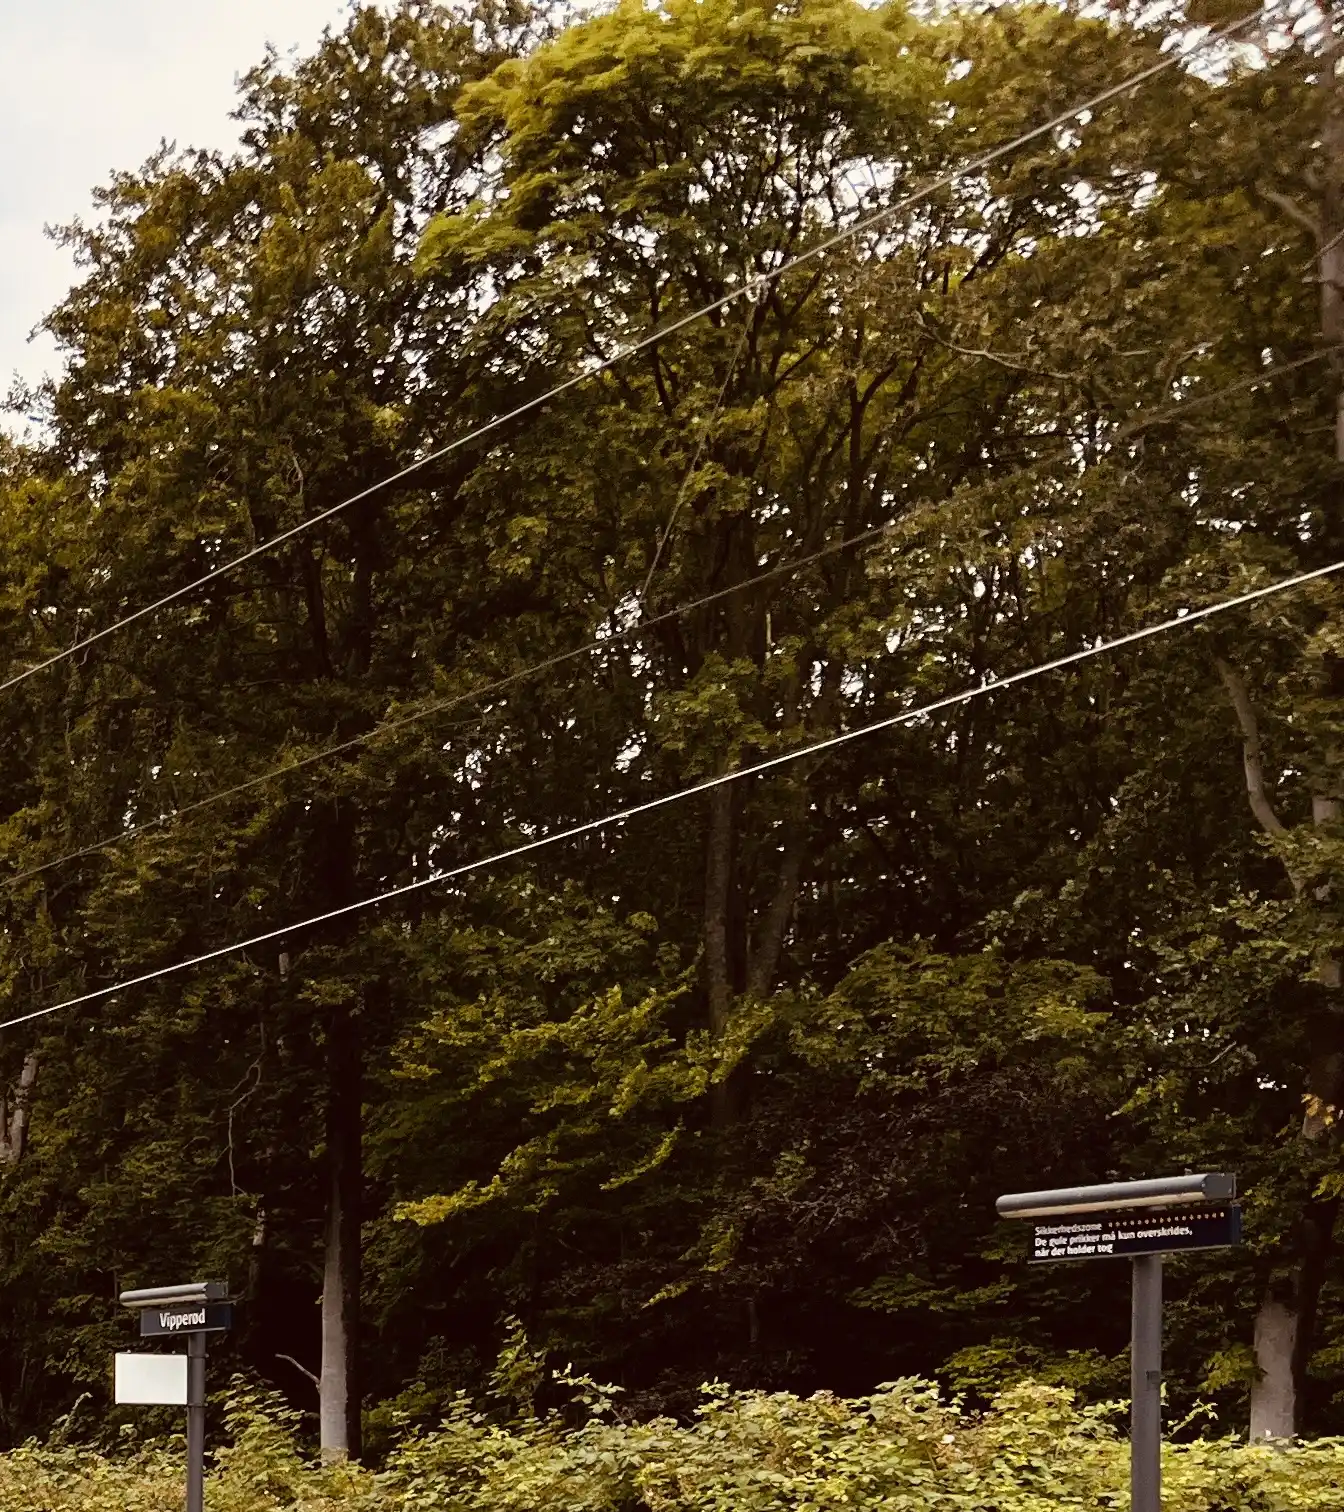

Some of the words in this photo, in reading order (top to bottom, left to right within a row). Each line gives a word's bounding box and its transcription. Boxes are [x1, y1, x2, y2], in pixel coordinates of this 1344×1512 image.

[1034, 1237, 1048, 1247] De
[1049, 1236, 1068, 1247] gule
[1069, 1233, 1100, 1246] prikker
[1101, 1230, 1116, 1241] må
[1117, 1230, 1136, 1240] kun
[1034, 1247, 1050, 1257] når
[1050, 1247, 1066, 1256] der
[1066, 1243, 1096, 1255] holder
[1097, 1243, 1113, 1254] tog
[159, 1308, 206, 1331] Vipperød
